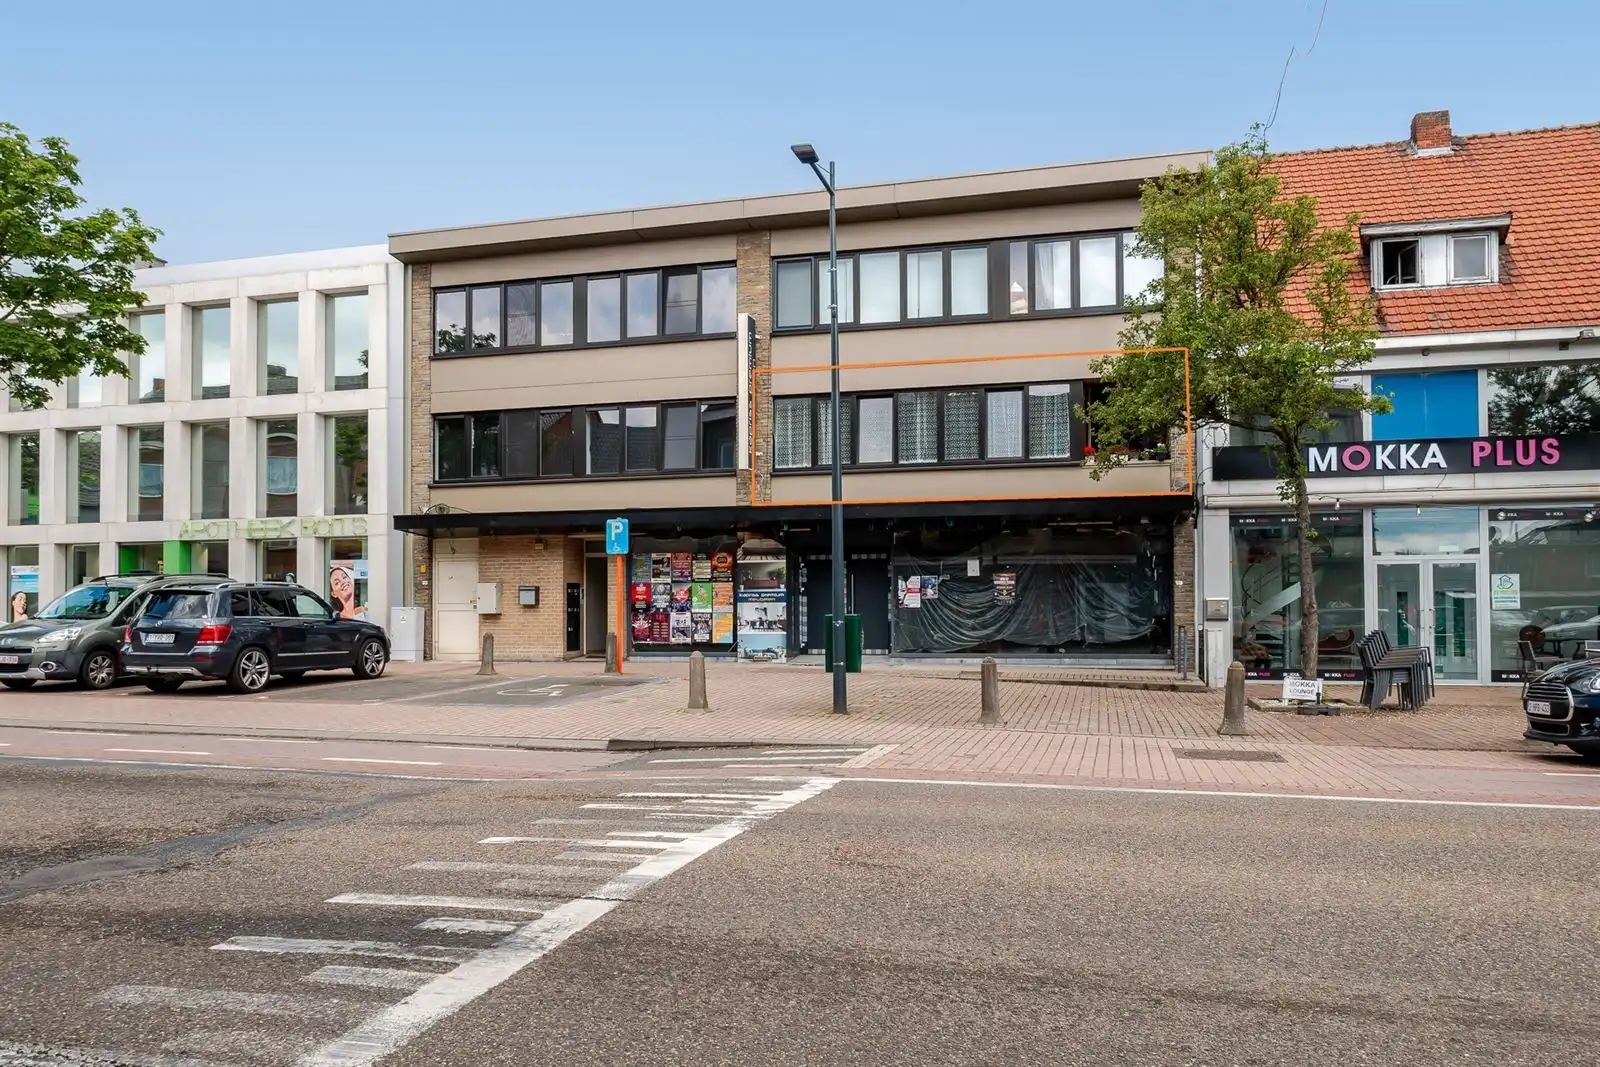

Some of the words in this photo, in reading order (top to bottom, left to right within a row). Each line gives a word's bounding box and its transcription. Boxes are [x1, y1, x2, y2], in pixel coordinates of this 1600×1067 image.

[1308, 442, 1448, 472] MOKKA
[1472, 438, 1561, 467] PLUS
[611, 521, 624, 541] P
